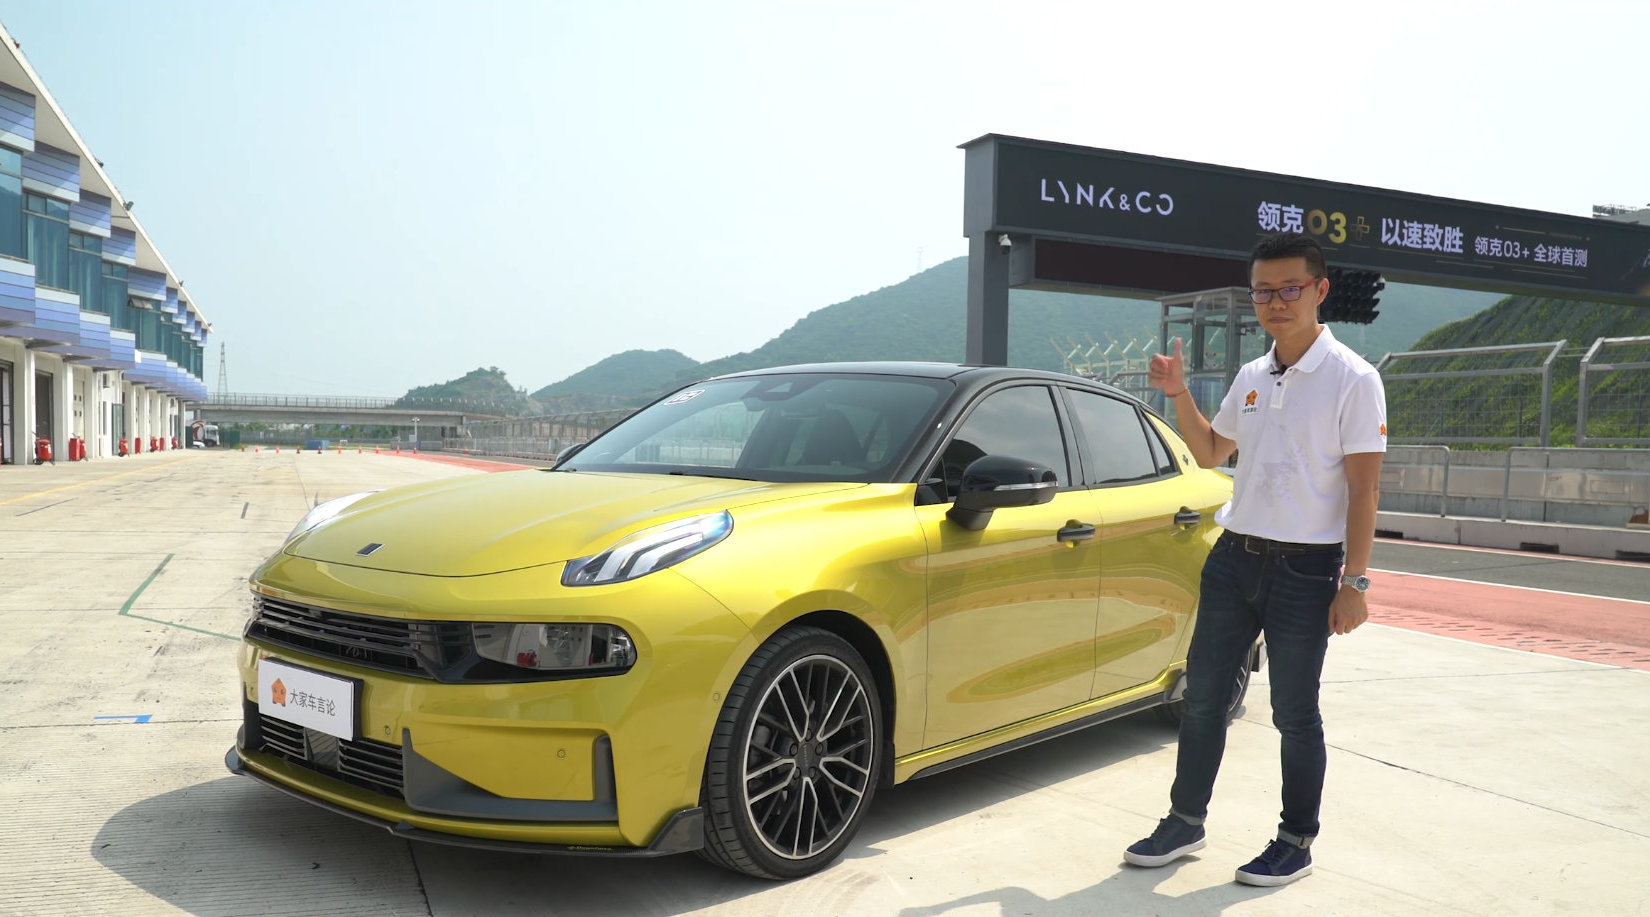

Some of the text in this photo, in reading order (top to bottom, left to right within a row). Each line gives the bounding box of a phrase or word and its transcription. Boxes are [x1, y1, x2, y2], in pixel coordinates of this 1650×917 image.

[1041, 178, 1174, 216] LYNK&CO
[1380, 216, 1464, 254] 以速致胜
[1474, 235, 1588, 268] 领克03+ 全球首测
[289, 687, 336, 717] 大家车言论
